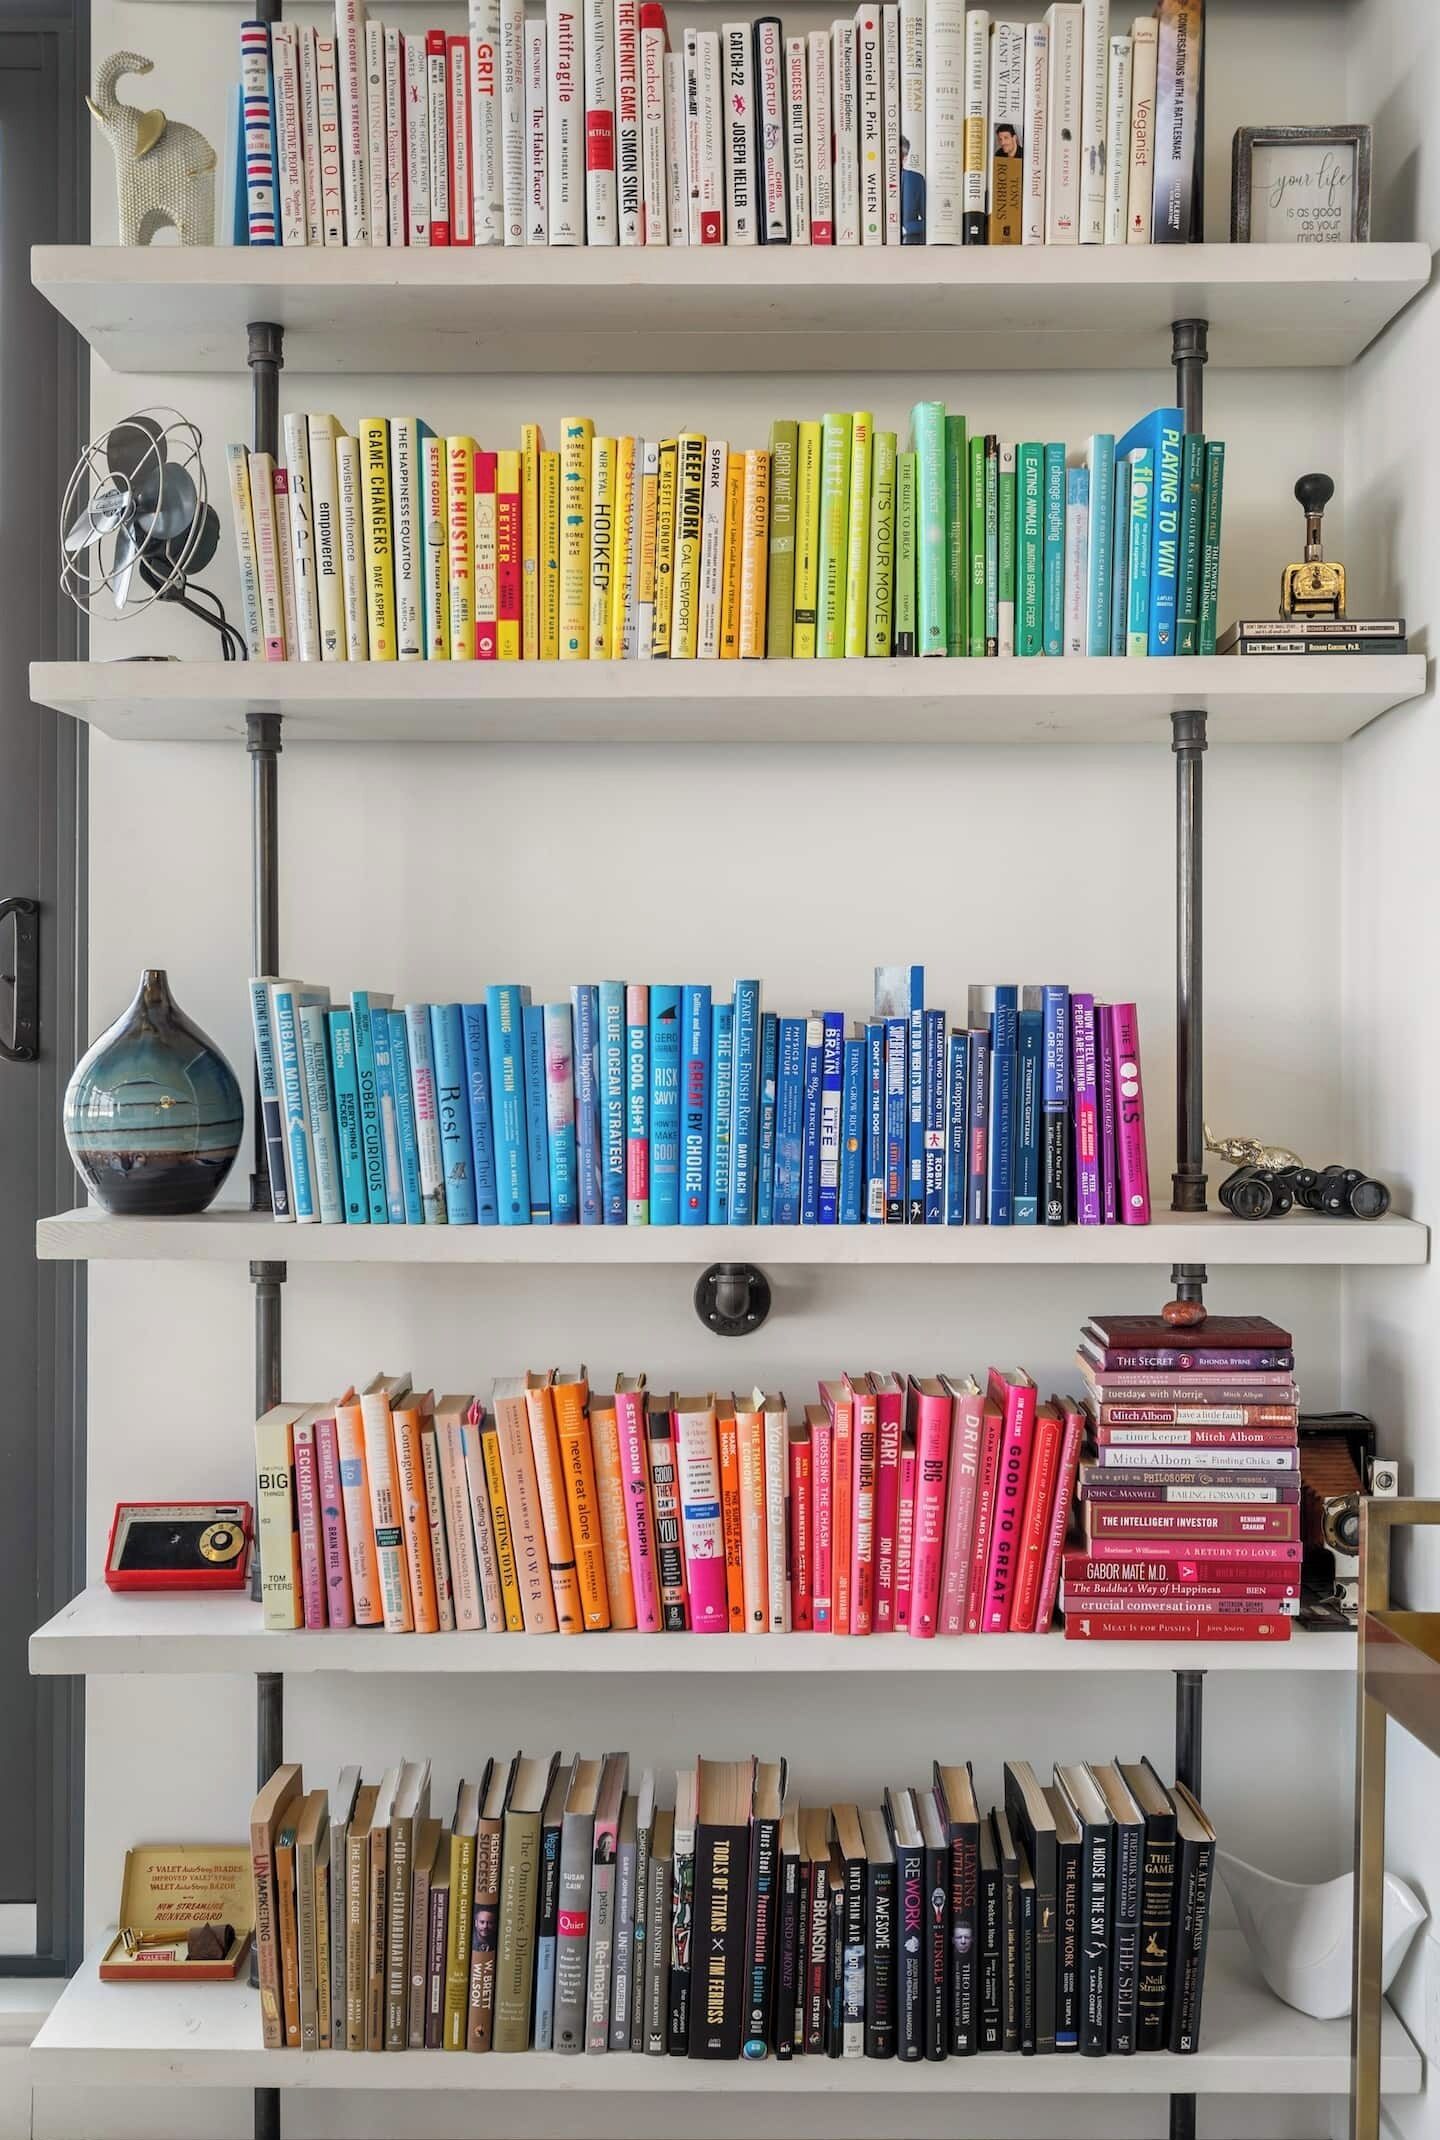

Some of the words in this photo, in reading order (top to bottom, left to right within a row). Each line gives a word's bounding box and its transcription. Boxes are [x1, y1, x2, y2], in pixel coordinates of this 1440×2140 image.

[620, 2, 634, 25] THE
[556, 13, 574, 102] Antifragile
[620, 29, 635, 82] INFINITE
[730, 32, 744, 86] CATCH-22
[865, 41, 876, 86] Daniel
[998, 25, 1008, 65] GIANT
[1012, 33, 1023, 84] AWAKEN
[1177, 13, 1188, 76] CONVERSATIONS
[284, 68, 293, 100] HIGHLY
[319, 43, 334, 91] DIE
[478, 44, 493, 96] GRIT
[646, 35, 660, 108] Attached.
[622, 87, 636, 122] GAME
[866, 91, 876, 105] H.
[998, 70, 1008, 118] WITHIN
[1011, 88, 1020, 112] THE
[1174, 79, 1184, 97] WITH
[286, 103, 296, 149] EFFECTIVE
[732, 122, 746, 164] JOSEPH
[866, 112, 877, 140] Pink
[1134, 99, 1151, 166] Veganist
[1172, 108, 1184, 160] RATTLESNAKE
[288, 151, 298, 184] PEOPLE
[322, 124, 339, 216] BROKE
[622, 130, 636, 172] SIMON
[623, 177, 638, 214] SINEK
[734, 169, 747, 207] HELLER
[868, 173, 876, 212] WHEN
[996, 163, 1007, 220] ROBBINS
[1010, 177, 1018, 208] TONY
[1270, 172, 1312, 208] your
[1316, 152, 1352, 207] life
[1287, 208, 1295, 217] is
[1297, 208, 1309, 216] as
[1312, 208, 1341, 219] good
[1302, 221, 1314, 230] as
[1317, 221, 1340, 231] your
[1297, 232, 1323, 242] mind
[1326, 232, 1341, 242] set
[369, 430, 383, 470] GAME
[399, 427, 408, 449] THE
[599, 451, 608, 468] NIR
[685, 441, 702, 481] DEEP
[711, 449, 720, 488] SPARK
[1160, 429, 1179, 503] PLAYING
[400, 452, 409, 516] HAPPINESS
[598, 472, 607, 496] EYAL
[878, 482, 891, 511] IT'S
[1050, 466, 1062, 500] change
[371, 477, 388, 554] CHANGERS
[499, 504, 510, 562] BETTER
[683, 488, 699, 540] WORK
[1049, 502, 1062, 541] anything
[1160, 510, 1177, 532] TO
[318, 502, 335, 575] empowered
[401, 520, 411, 580] EQUATION
[593, 504, 610, 588] HOOKED
[681, 544, 692, 568] CAL
[876, 517, 890, 566] YOUR
[374, 566, 383, 589] DAVE
[1158, 540, 1175, 577] WIN
[375, 592, 385, 628] ASPREY
[679, 572, 690, 632] NEWPORT
[875, 572, 889, 624] MOVE
[279, 1010, 296, 1062] URBAN
[607, 1006, 620, 1041] BLUE
[1048, 1032, 1055, 1047] OR
[718, 1032, 731, 1056] THE
[825, 1029, 836, 1074] BRAIN
[1055, 1008, 1064, 1092] DIFFERENTIATE
[287, 1068, 301, 1112] MONK
[608, 1048, 621, 1095] OCEAN
[688, 1060, 704, 1108] GREAT
[361, 1071, 375, 1119] SOBER
[716, 1062, 730, 1138] DRAGONFLY
[440, 1087, 461, 1143] Rest
[688, 1113, 702, 1131] BY
[823, 1108, 833, 1145] LIFE
[610, 1102, 622, 1174] STRATEGY
[366, 1125, 381, 1191] CURIOUS
[687, 1135, 702, 1191] CHOICE
[716, 1145, 728, 1192] EFFECT
[1117, 1356, 1135, 1366] THE
[1139, 1357, 1173, 1366] SECRET
[626, 1403, 637, 1434] SETH
[1017, 1398, 1025, 1409] JIM
[1112, 1411, 1139, 1420] Mitch
[1141, 1411, 1172, 1421] Albom
[1014, 1410, 1023, 1437] COLLINS
[1195, 1431, 1225, 1441] Mitch
[1229, 1431, 1264, 1442] Albom
[400, 1425, 415, 1492] Contagious
[570, 1440, 582, 1474] never
[629, 1437, 640, 1474] GODIN
[860, 1432, 874, 1461] GOOD
[880, 1422, 897, 1468] START.
[259, 1474, 288, 1489] BIG
[299, 1449, 313, 1507] ECKHART
[575, 1480, 585, 1499] eat
[859, 1464, 873, 1490] IDEA.
[1005, 1445, 1021, 1497] GOOD
[578, 1504, 591, 1540] alone
[859, 1493, 870, 1519] NOW
[1001, 1508, 1015, 1531] TO
[1103, 1516, 1117, 1526] THE
[1121, 1517, 1173, 1527] INTELLIGENT
[1177, 1518, 1218, 1527] INVESTOR
[303, 1512, 316, 1550] TOLLE
[635, 1502, 648, 1556] LINCHPIN
[857, 1523, 870, 1562] WHAT?
[897, 1500, 912, 1591] CREEPIOSITY
[993, 1541, 1011, 1603] GREAT
[1073, 1584, 1089, 1592] The
[1095, 1584, 1132, 1593] Buddha's
[1138, 1584, 1155, 1594] Way
[1160, 1584, 1170, 1594] of
[1172, 1584, 1221, 1594] Happiness
[1087, 1564, 1120, 1579] GABOR
[1122, 1562, 1144, 1580] MATÉ
[1082, 1600, 1124, 1610] crucial
[1127, 1601, 1212, 1611] conversations
[478, 1834, 489, 1893] SUCCESS
[489, 1834, 499, 1893] REDEFINING
[521, 1832, 534, 1857] The
[544, 1832, 559, 1860] Vegan
[712, 1840, 730, 1874] TOOLS
[1150, 1855, 1171, 1863] THE
[713, 1878, 729, 1890] OF
[817, 1870, 825, 1898] RICHARD
[850, 1867, 861, 1891] INTO
[1144, 1864, 1174, 1874] GAME
[254, 1854, 271, 1941] UNMARKETING
[517, 1862, 531, 1932] Omnivore's
[711, 1894, 727, 1932] TITANS
[849, 1896, 860, 1920] THIN
[905, 1857, 920, 1931] REWORK
[811, 1900, 825, 1962] BRANSON
[849, 1924, 860, 1942] AIR
[876, 1896, 889, 1949] AWESOME
[483, 1960, 493, 1973] W.
[514, 1937, 528, 1994] Dilemma
[710, 1956, 726, 1975] TIM
[934, 1933, 943, 1984] JUNGLE
[1120, 1934, 1135, 1972] THE
[472, 1963, 482, 2007] WILSON
[482, 1976, 492, 2009] BRETT
[591, 1941, 609, 2022] Re-imagine
[1117, 1977, 1133, 2023] SELL
[707, 1979, 725, 2024] FERRISS
